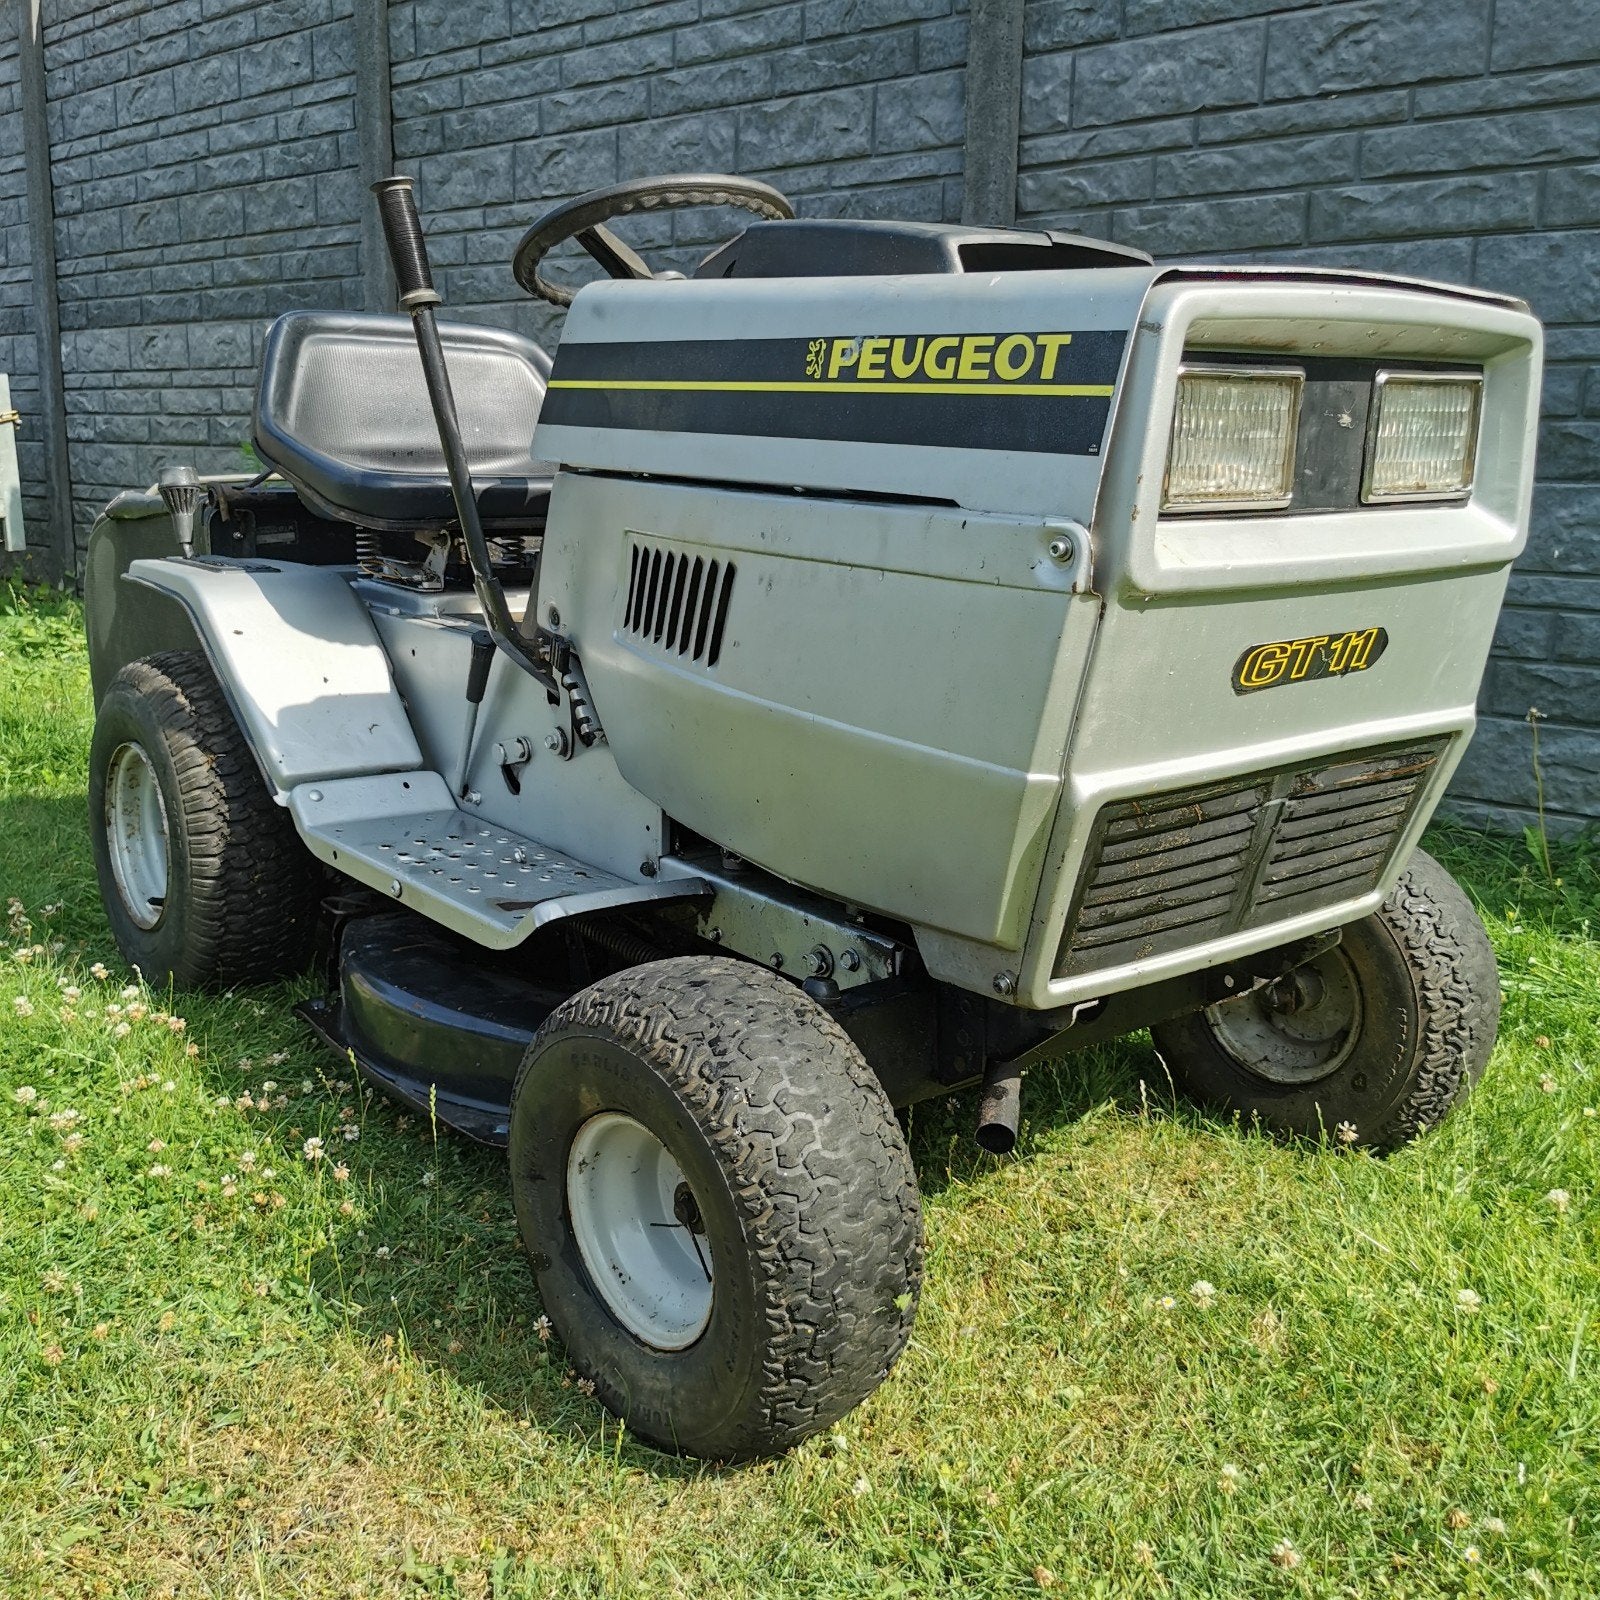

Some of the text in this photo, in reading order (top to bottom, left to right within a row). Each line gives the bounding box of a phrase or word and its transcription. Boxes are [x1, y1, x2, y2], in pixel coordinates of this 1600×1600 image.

[827, 334, 1072, 381] PEUGEOT
[1239, 628, 1378, 687] GT 11
